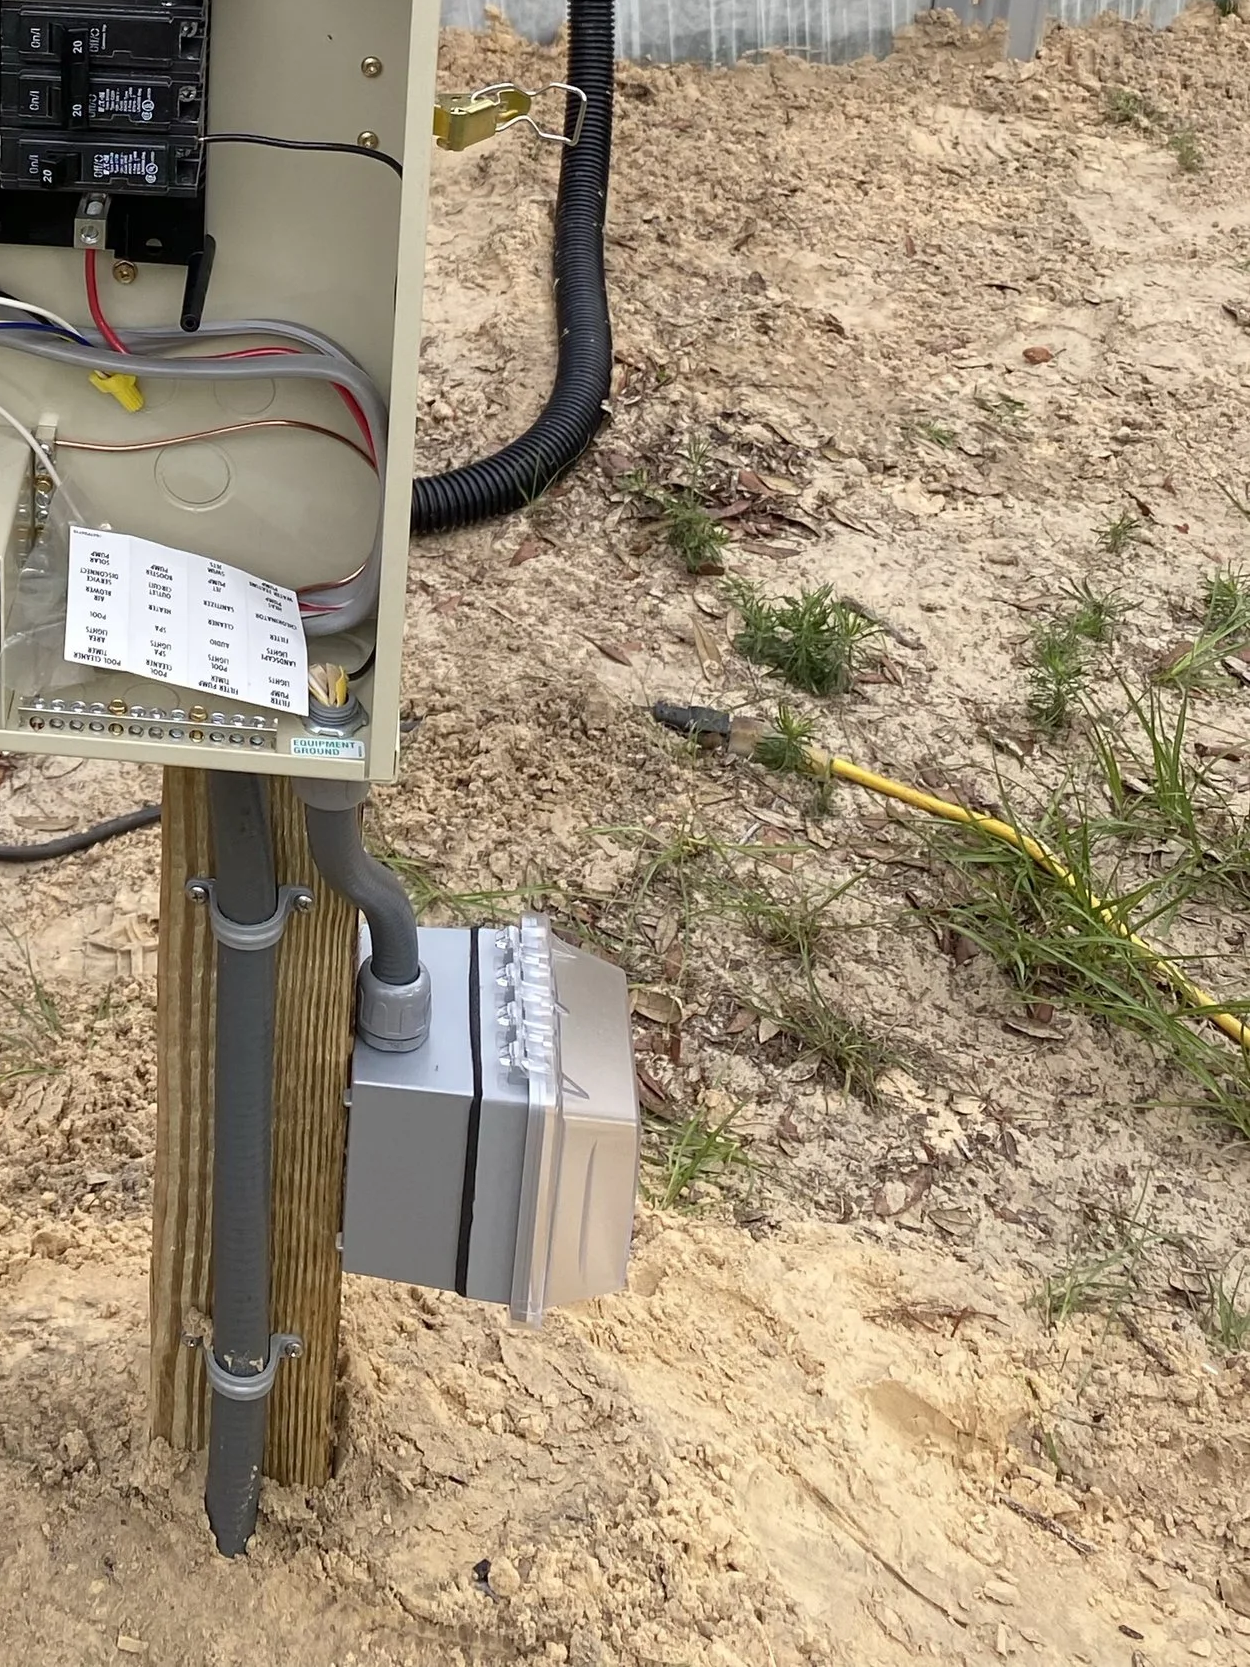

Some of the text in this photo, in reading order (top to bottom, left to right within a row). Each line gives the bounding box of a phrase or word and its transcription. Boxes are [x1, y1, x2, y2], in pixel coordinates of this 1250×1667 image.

[72, 40, 82, 54] 20
[72, 104, 82, 117] 20
[43, 169, 53, 183] 20
[89, 557, 110, 566] SOLAR
[80, 568, 118, 579] DISCONNECT
[151, 564, 168, 573] PUMP
[207, 567, 225, 576] SWIM
[145, 569, 173, 580] BOOSTER
[86, 575, 112, 585] SERVICE
[208, 578, 225, 587] PUMP
[85, 586, 112, 596] BLOWER
[148, 582, 172, 592] CIRCUIT
[149, 588, 171, 599] OUTLET
[148, 604, 171, 614] HEATER
[203, 600, 234, 612] SANITIZER
[90, 611, 107, 620] POOL
[155, 625, 166, 633] SPA
[208, 619, 234, 630] CLEANER
[85, 626, 108, 636] LIGHTS
[88, 634, 105, 643] AREA
[209, 639, 230, 648] AUDIO
[269, 634, 289, 643] FILTER
[150, 640, 171, 650] LIGHTS
[88, 647, 108, 656] TIMER
[154, 649, 166, 657] SPA
[266, 647, 288, 658] LIGHTS
[73, 651, 121, 666] POOL CLEANER
[208, 654, 229, 664] LIGHTS
[146, 659, 173, 671] CLEANER
[211, 663, 228, 672] POOL
[150, 668, 167, 677] POOL
[211, 675, 229, 685] TIMER
[268, 676, 290, 687] LIGHTS
[198, 680, 238, 695] FILTER PUMP
[270, 690, 289, 700] PUMP
[270, 697, 290, 707] FILTER
[293, 740, 355, 748] EQUIPMENT
[294, 747, 340, 755] GROUND
